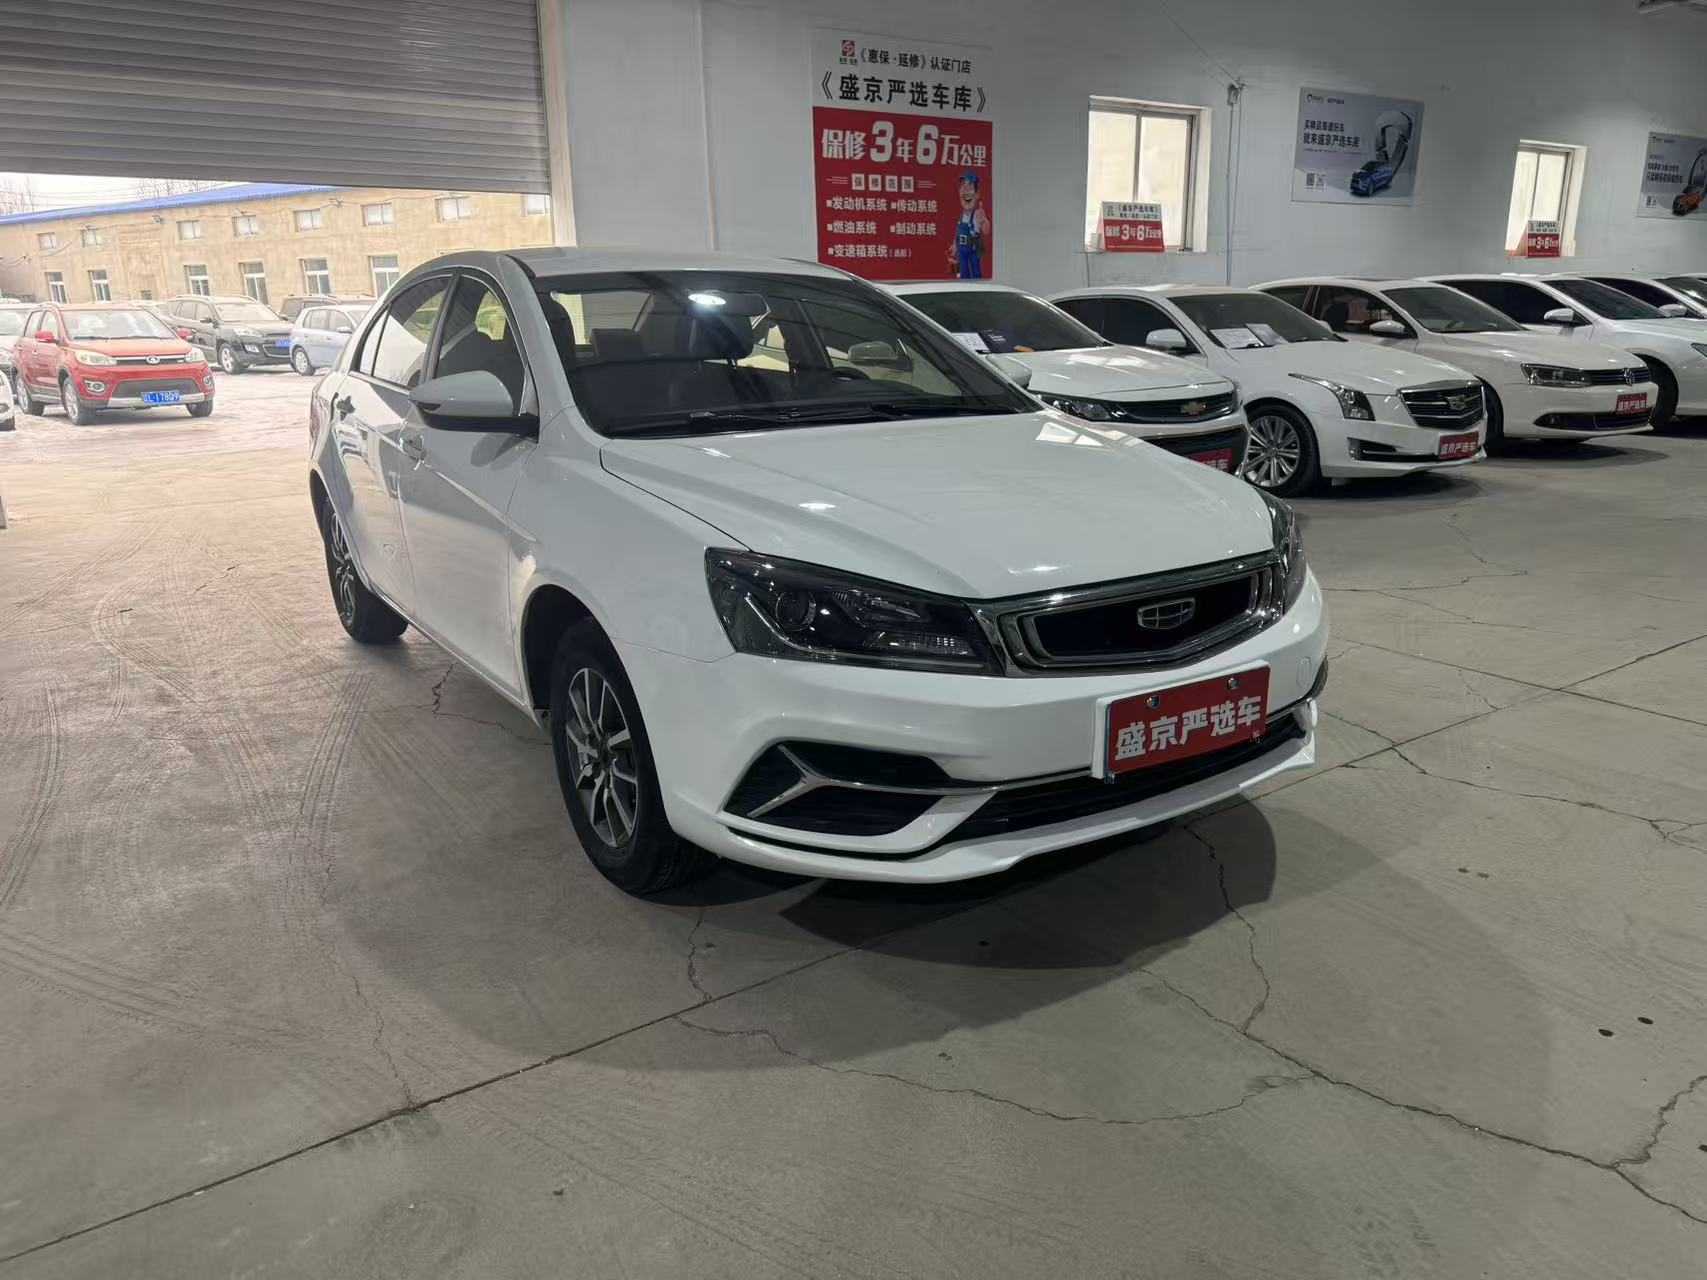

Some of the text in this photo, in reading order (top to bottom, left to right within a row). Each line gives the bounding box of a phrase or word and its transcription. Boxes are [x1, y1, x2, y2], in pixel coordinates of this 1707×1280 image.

[821, 71, 986, 113] 《盛京严选车库》
[822, 120, 987, 168] 保修3年6万公里
[832, 196, 938, 213] 发动机系统 传动系统
[832, 220, 937, 236] 燃油系统 制动系统
[1115, 695, 1262, 761] 盛京严选车
